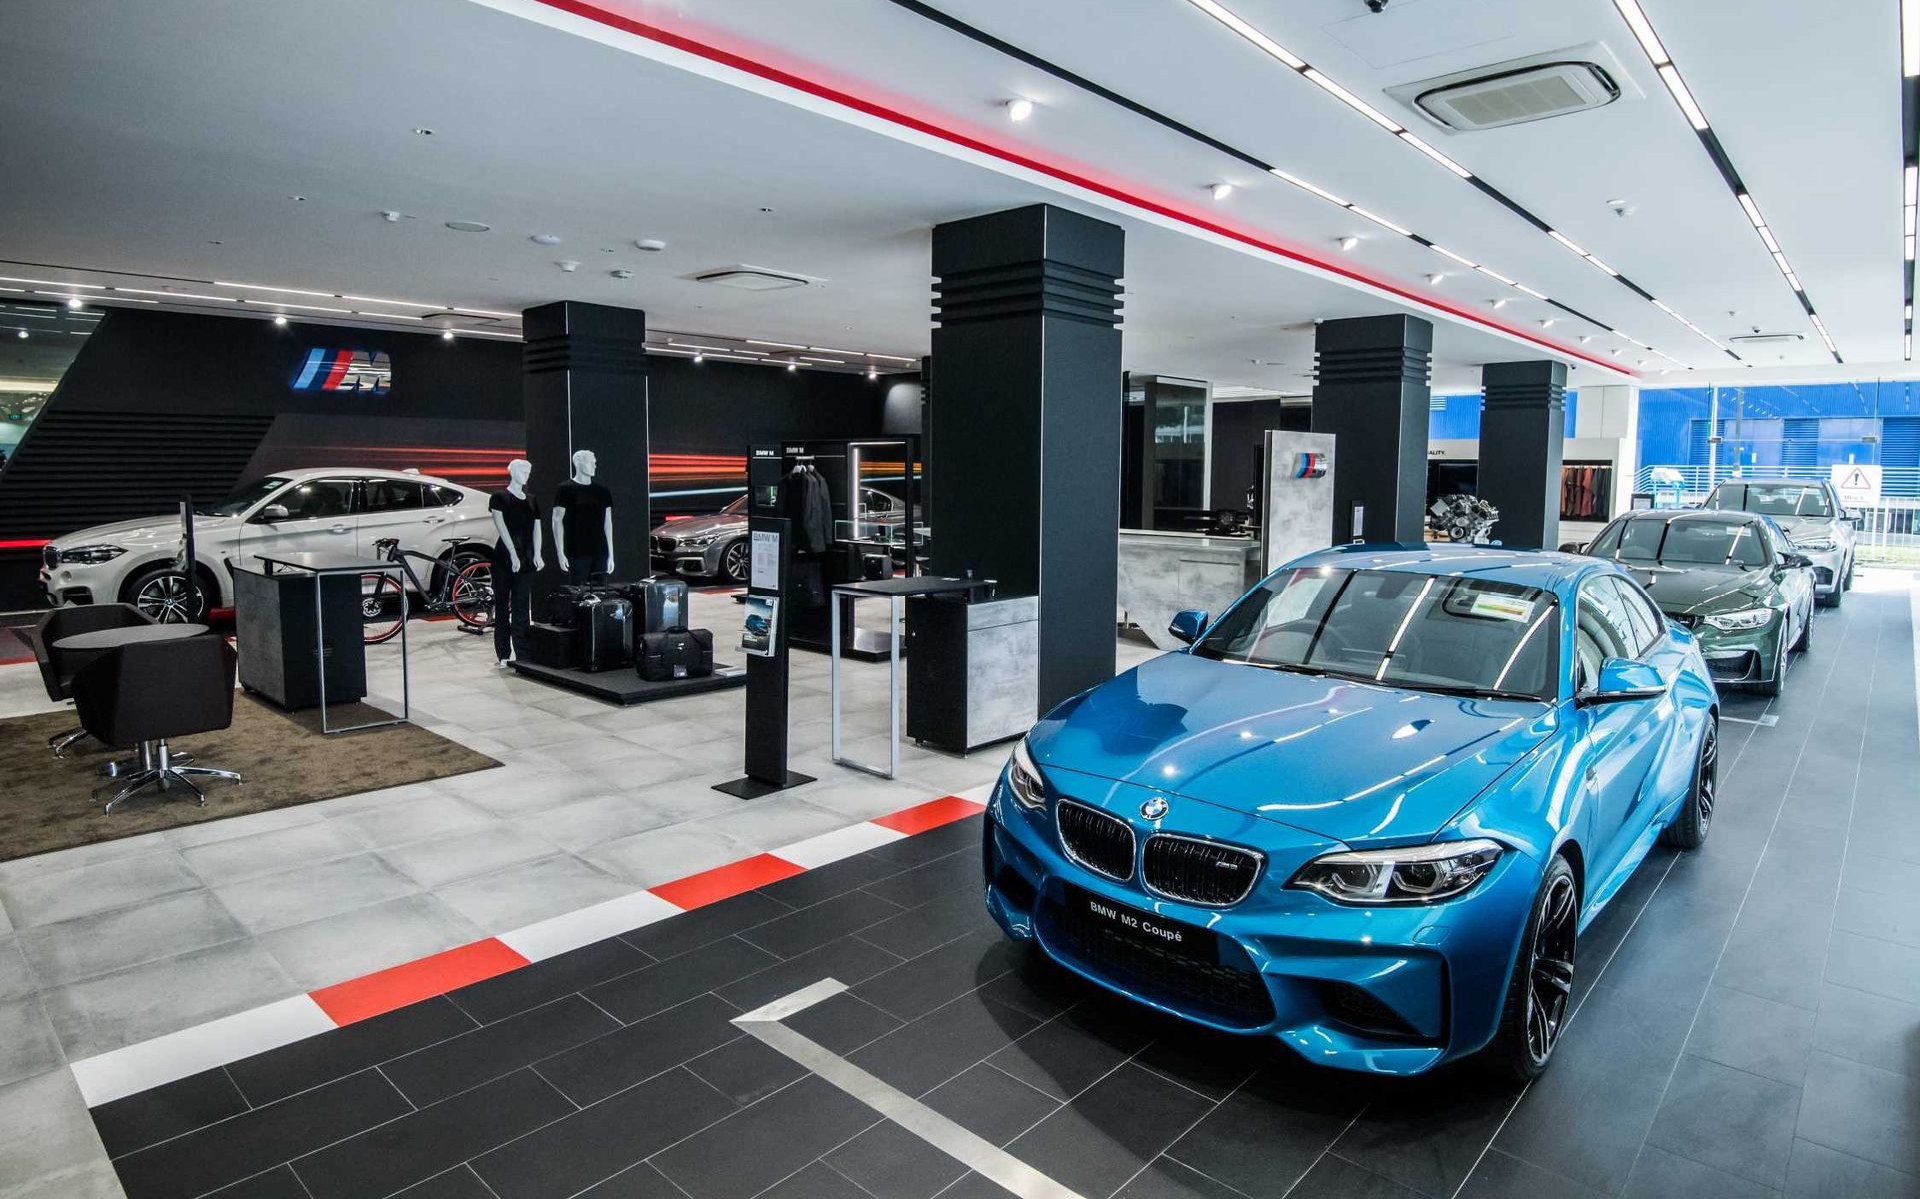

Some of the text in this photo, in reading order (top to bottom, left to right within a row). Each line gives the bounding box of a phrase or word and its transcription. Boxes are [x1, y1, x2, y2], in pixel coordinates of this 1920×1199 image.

[753, 532, 770, 542] BMW
[1090, 901, 1183, 942] BMW M2 Coupé
